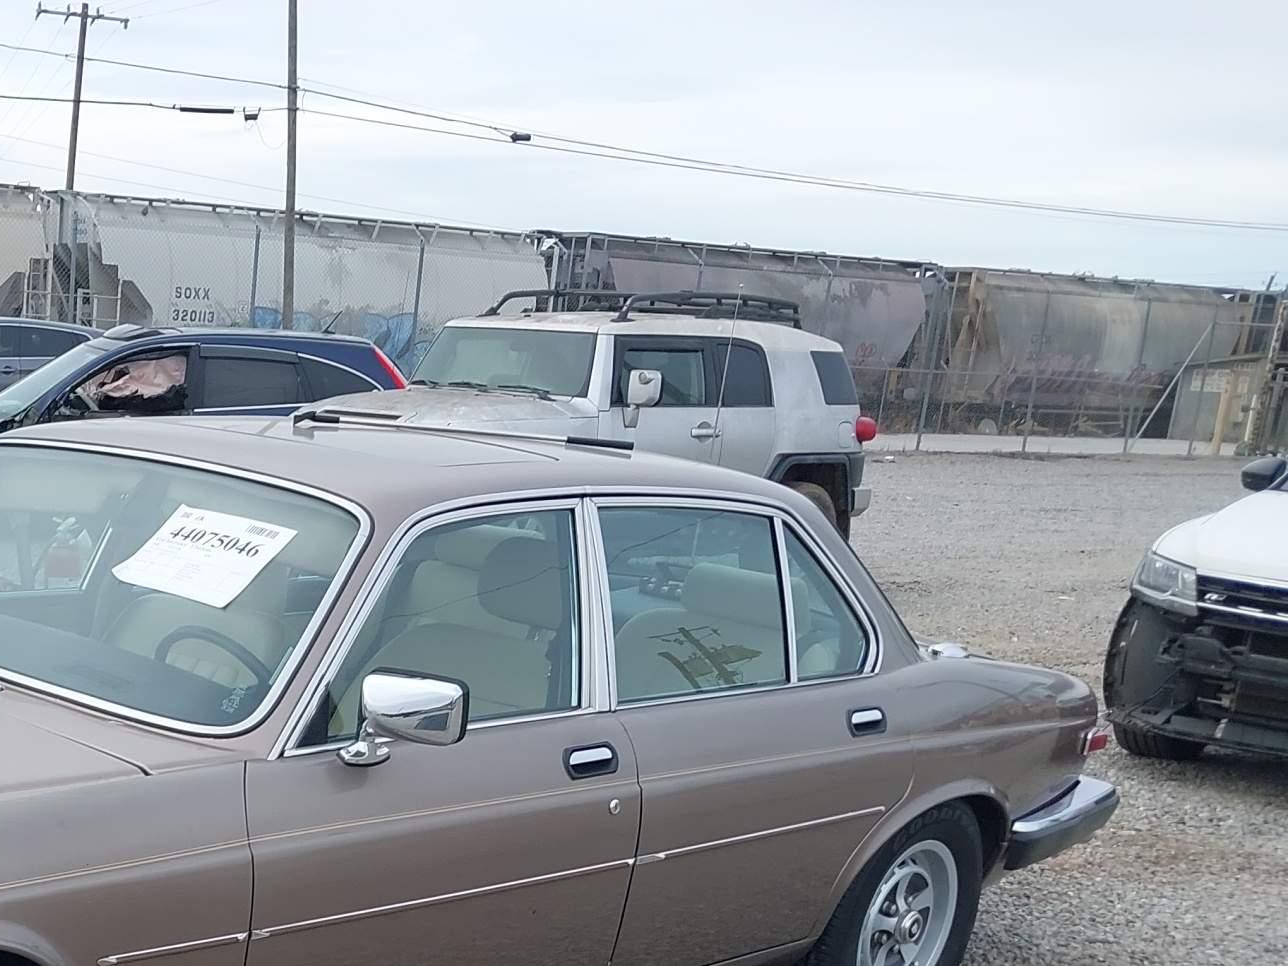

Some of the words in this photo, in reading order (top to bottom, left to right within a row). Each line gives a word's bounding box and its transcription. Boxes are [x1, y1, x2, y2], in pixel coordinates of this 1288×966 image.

[175, 286, 210, 300] SOXX
[172, 309, 215, 323] 320113
[169, 526, 263, 559] 44075046
